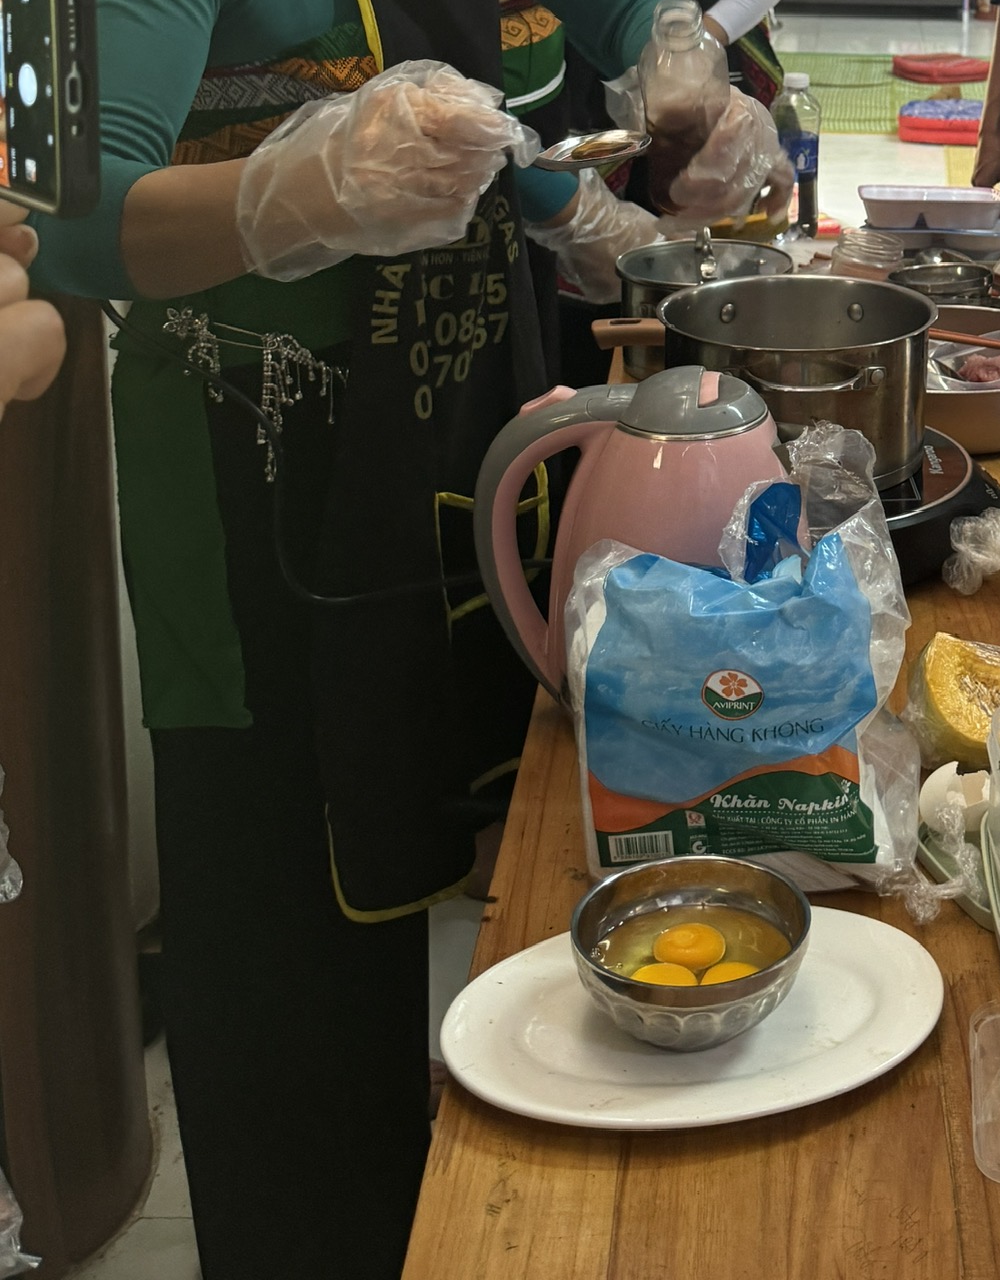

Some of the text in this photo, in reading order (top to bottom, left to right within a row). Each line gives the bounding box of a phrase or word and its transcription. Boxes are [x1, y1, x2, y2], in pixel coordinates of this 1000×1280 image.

[371, 264, 412, 344] NHÀ
[713, 701, 757, 711] AVIPRINT
[689, 722, 744, 744] HÀNG
[710, 792, 850, 815] Khăn Napkin
[760, 816, 783, 825] CÔNG
[784, 818, 793, 826] TY
[830, 816, 839, 824] IN
